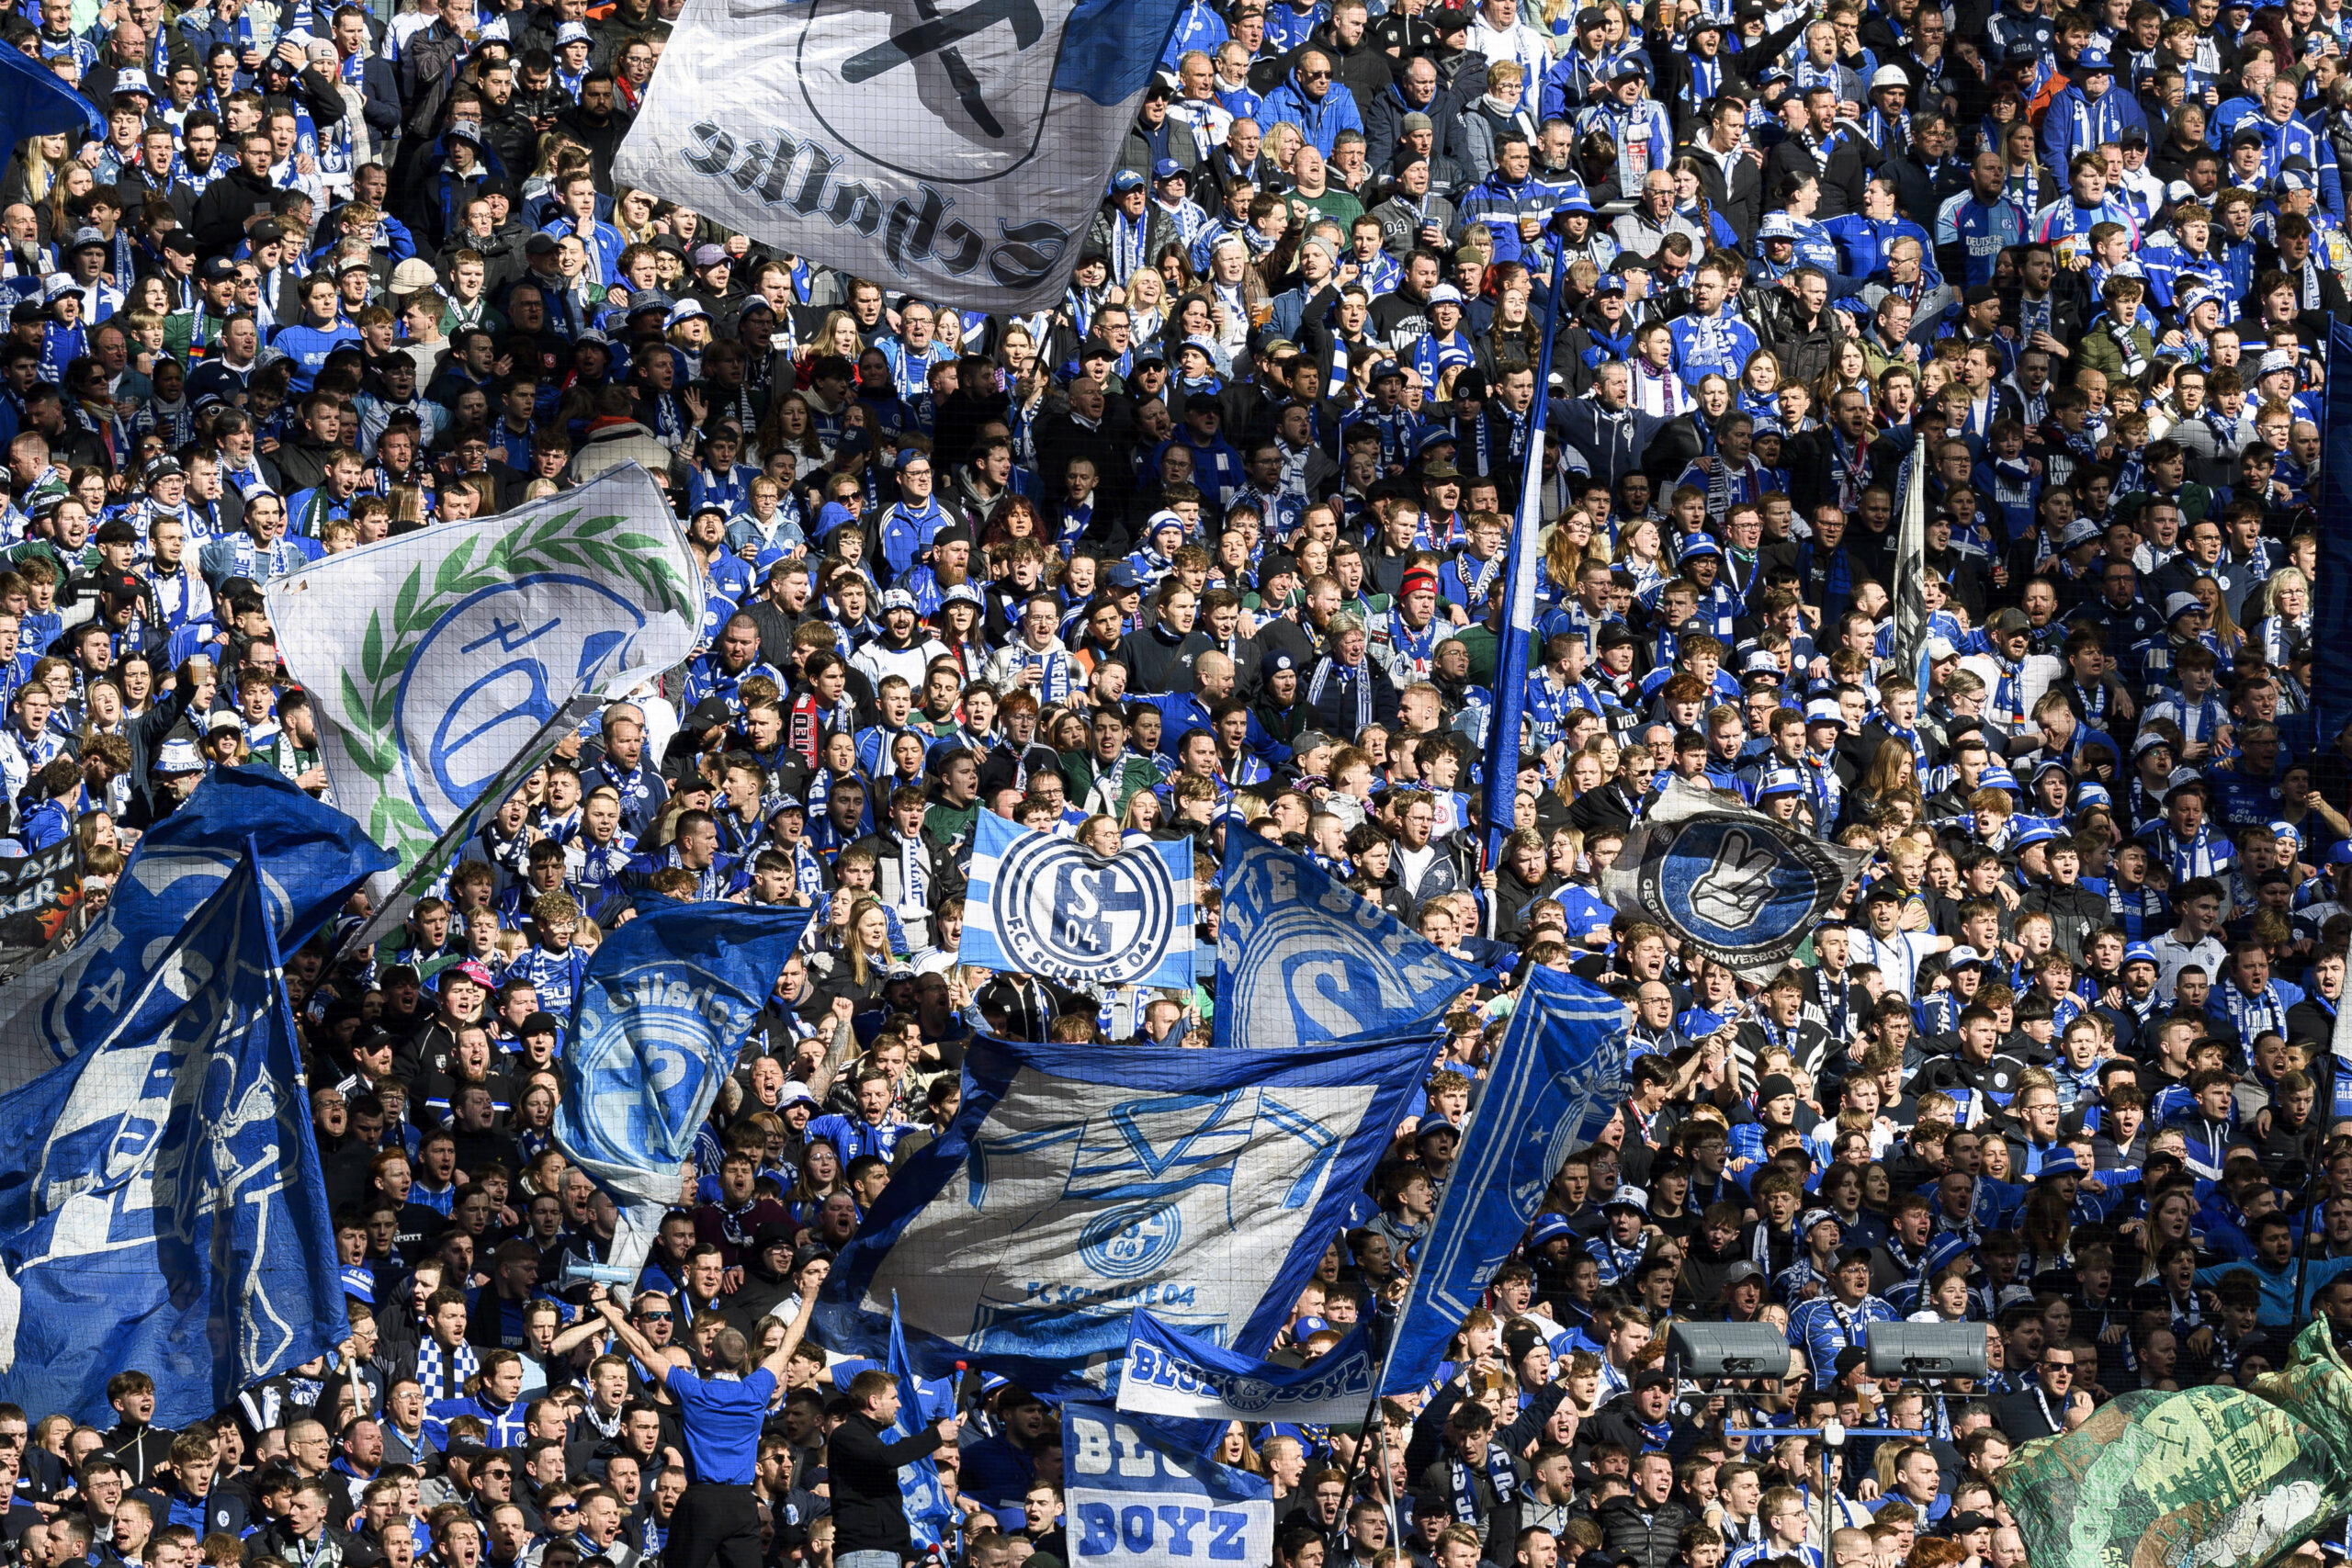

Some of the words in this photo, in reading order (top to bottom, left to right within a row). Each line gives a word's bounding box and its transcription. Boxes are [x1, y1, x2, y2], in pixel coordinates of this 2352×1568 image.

[2013, 43, 2034, 53] 1904
[1383, 220, 1407, 236] 04
[1965, 235, 2006, 246] DEUTSCHE
[17, 841, 75, 886] ALL
[1006, 916, 1031, 953] F.C.
[1028, 950, 1125, 983] SCHALKE
[1127, 938, 1154, 969] 04
[1064, 919, 1102, 953] 04
[1027, 1280, 1053, 1303] FC
[1162, 1283, 1198, 1308] 04
[1078, 1503, 1249, 1561] BOYZ
